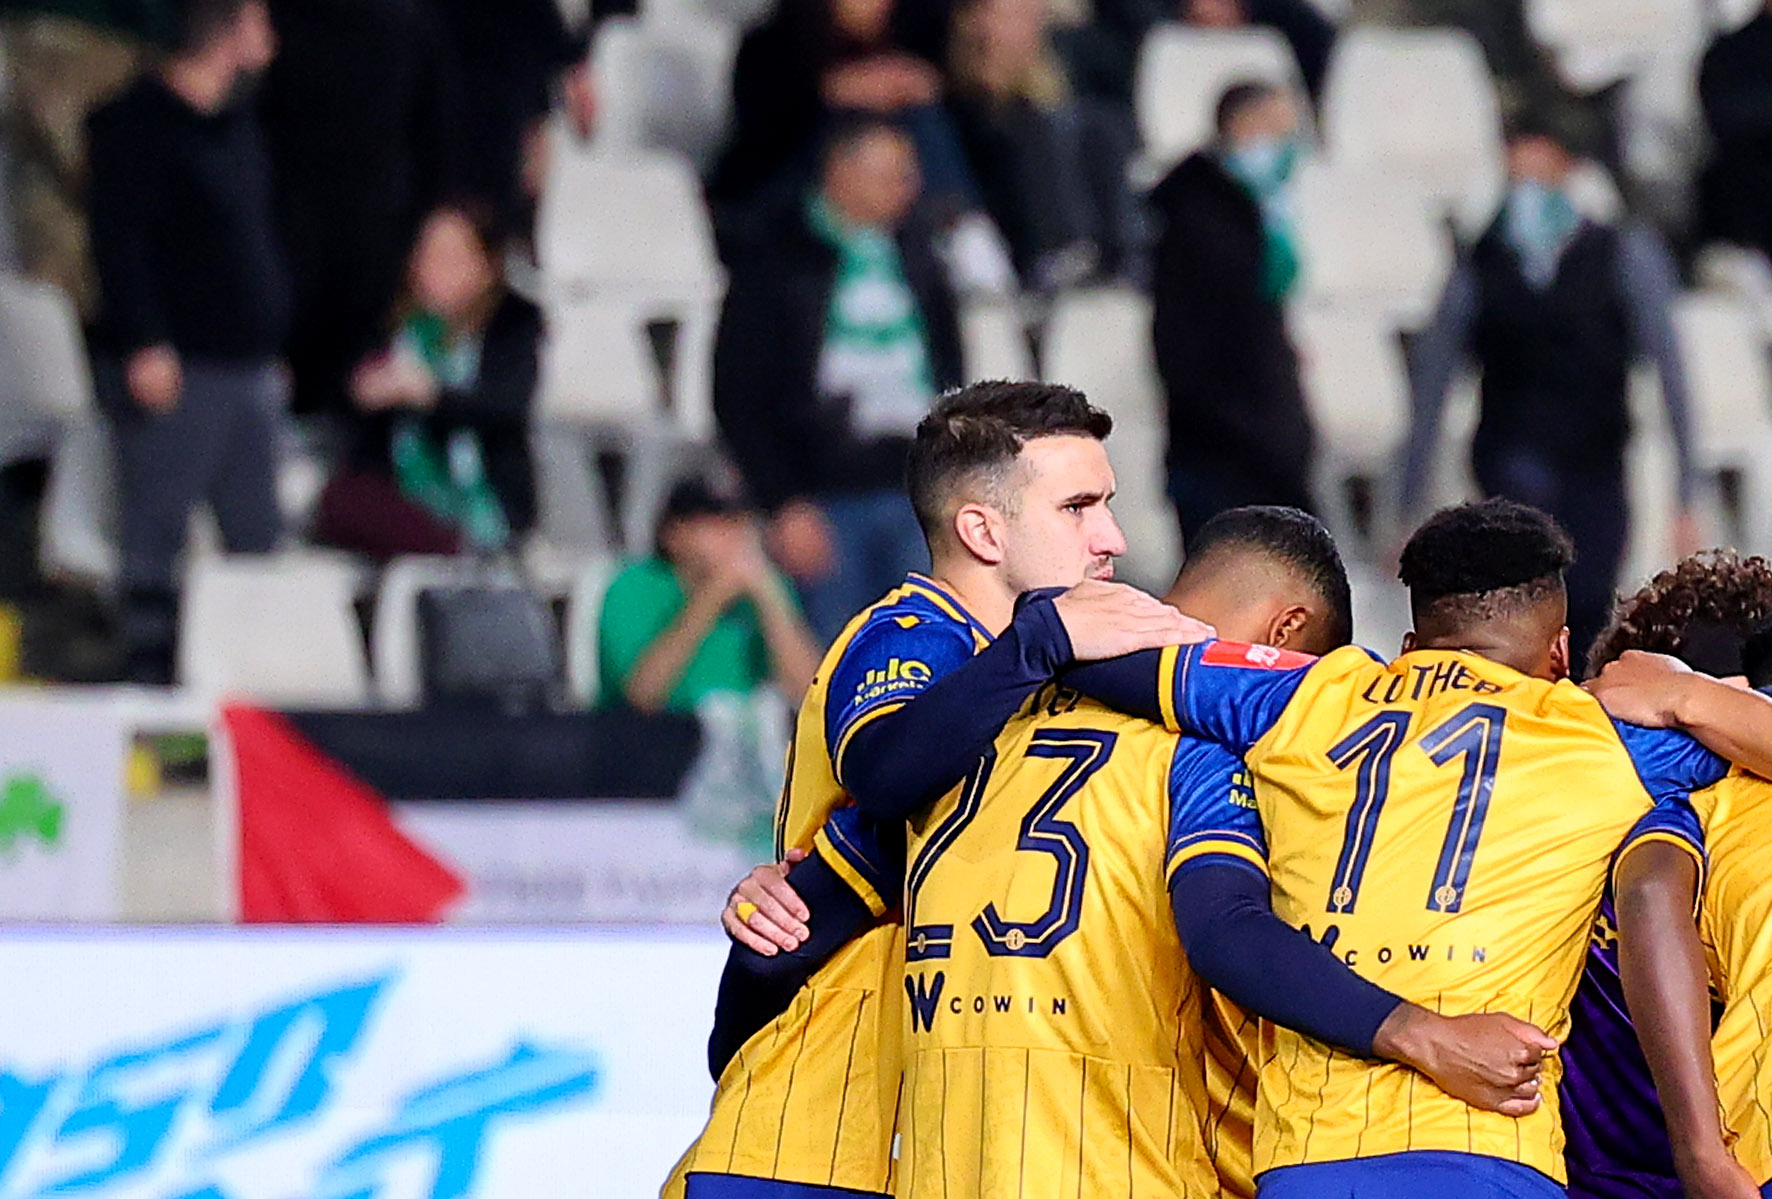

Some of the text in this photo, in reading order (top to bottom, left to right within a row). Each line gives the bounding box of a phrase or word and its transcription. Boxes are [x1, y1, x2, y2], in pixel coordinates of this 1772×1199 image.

[905, 727, 1120, 962] 23
[1327, 701, 1507, 914] 11
[949, 995, 1067, 1015] COWIN
[1344, 943, 1487, 967] COWIN
